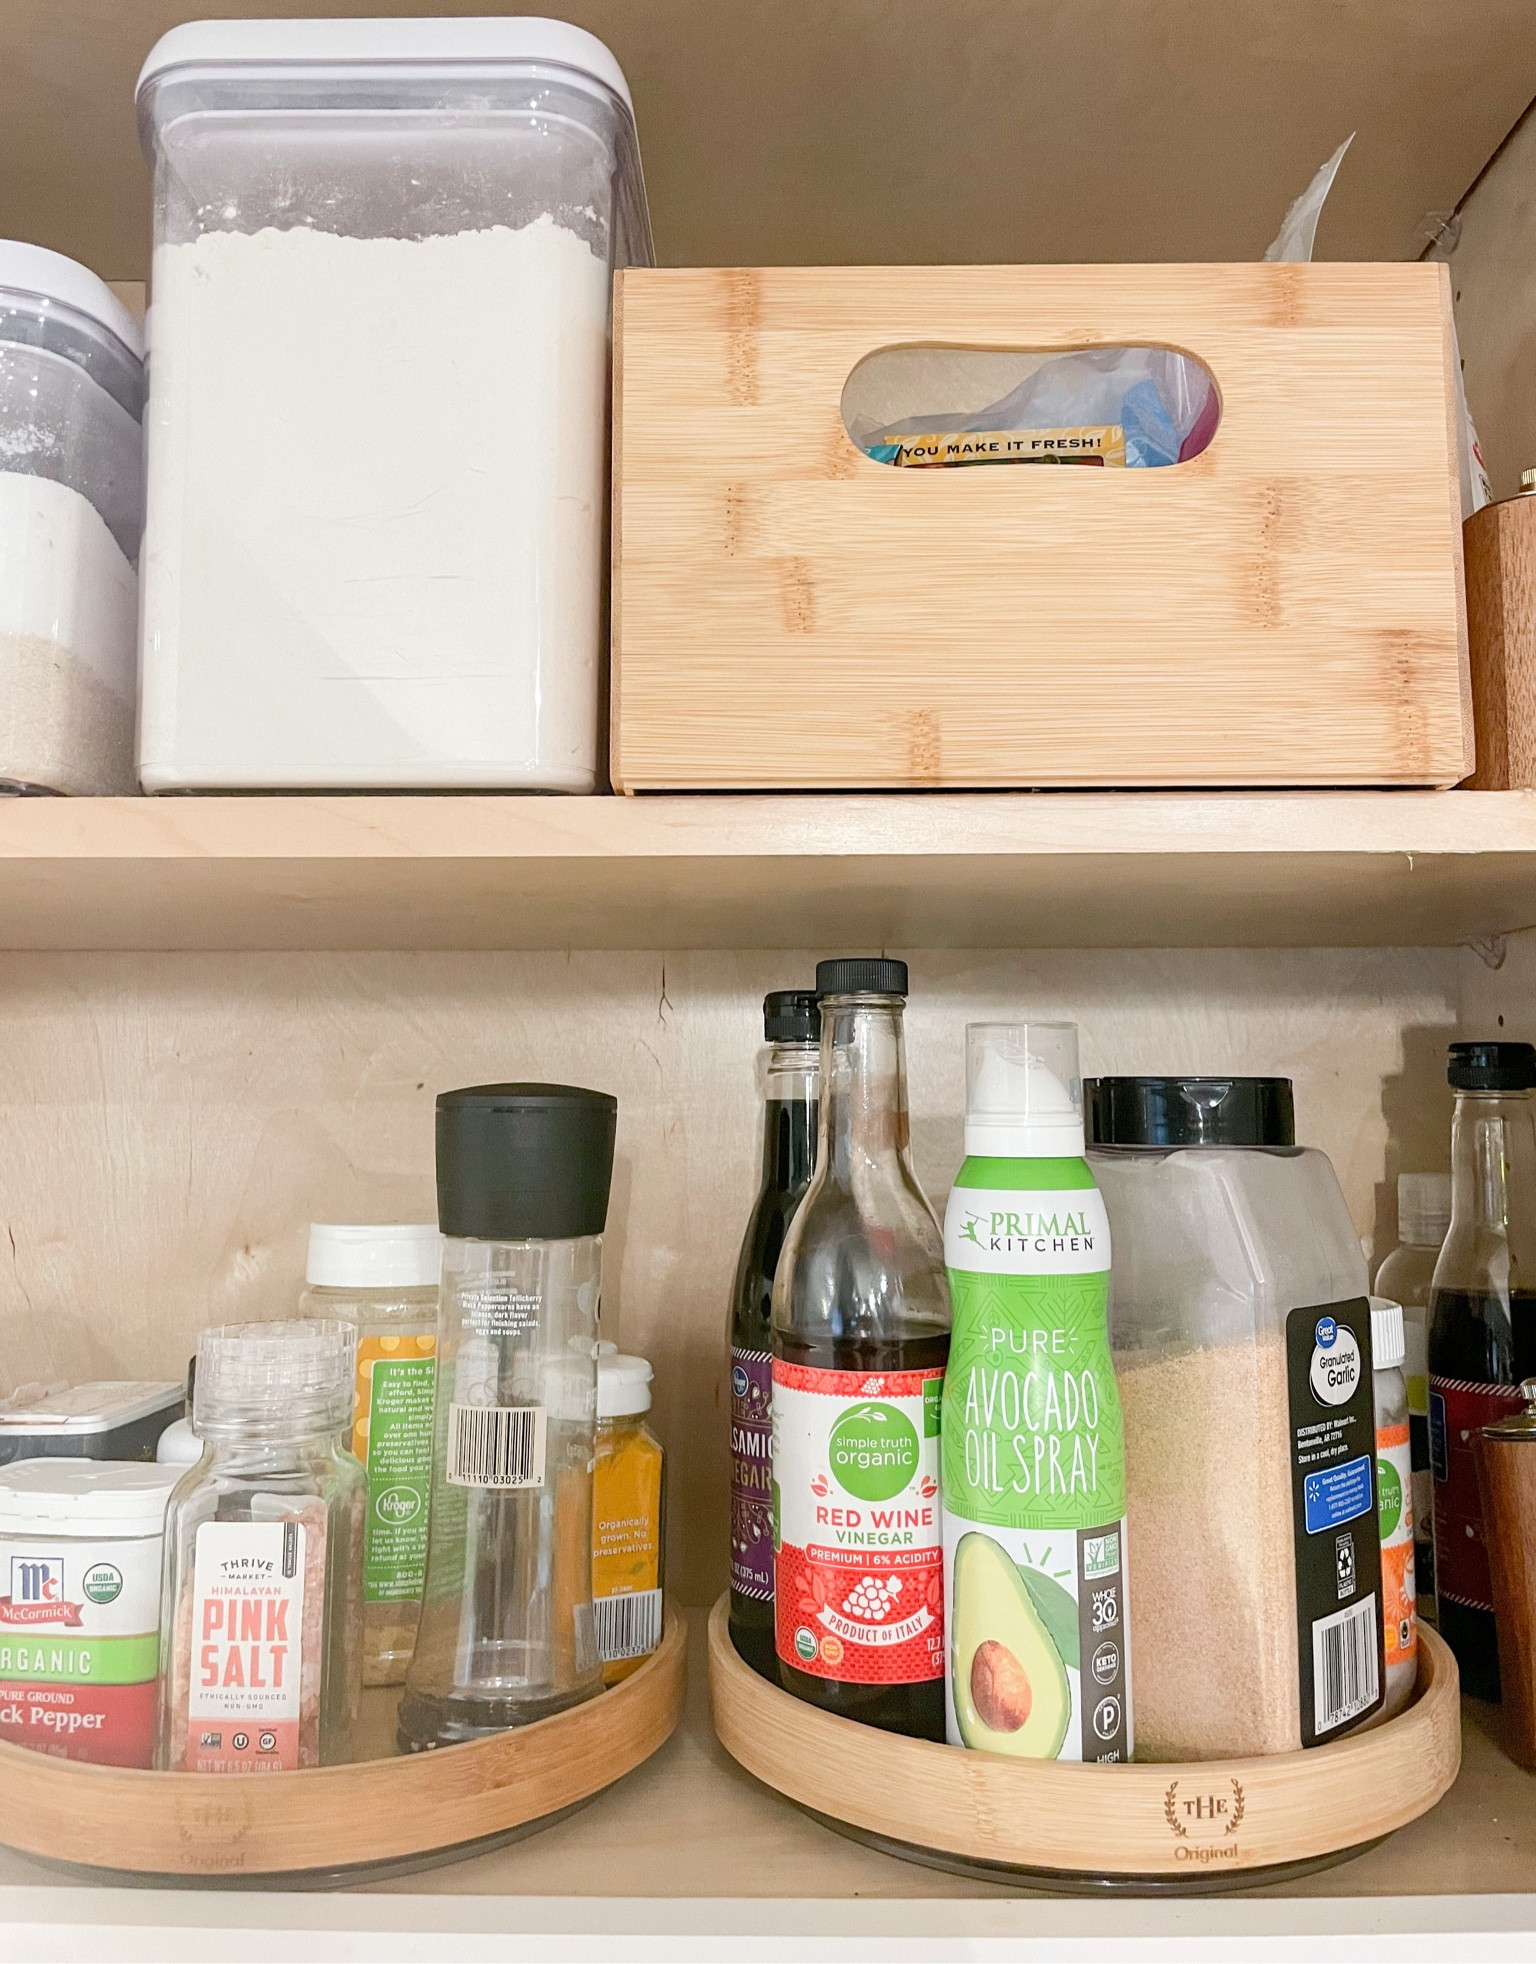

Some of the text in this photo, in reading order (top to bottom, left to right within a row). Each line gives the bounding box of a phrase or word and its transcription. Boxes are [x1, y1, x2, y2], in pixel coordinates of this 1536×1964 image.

[904, 438, 1102, 457] YOU MAKE IT FRESH!
[990, 1212, 1092, 1236] PRIMAL
[990, 1237, 1093, 1252] KITCHEN
[1318, 1324, 1334, 1336] Great
[992, 1328, 1066, 1354] PURE
[1320, 1350, 1355, 1369] Granulated
[389, 1367, 423, 1376] It's the
[1327, 1365, 1356, 1387] Garlic
[382, 1380, 400, 1388] Easy
[389, 1389, 415, 1397] afford,
[965, 1366, 1098, 1432] AVOCADO
[376, 1396, 430, 1406] Kroger makes
[377, 1440, 429, 1448] preservatives
[836, 1436, 912, 1448] simple truth
[380, 1456, 415, 1464] delicious
[384, 1448, 398, 1457] you
[836, 1448, 912, 1468] organic
[410, 1464, 424, 1472] you
[966, 1429, 1099, 1495] OIL SPRAY
[462, 1474, 488, 1484] 11110
[493, 1474, 524, 1485] 03025
[382, 1492, 416, 1518] Kroger
[598, 1516, 650, 1531] Organically
[816, 1506, 932, 1528] RED WINE
[402, 1527, 416, 1536] you
[634, 1530, 646, 1538] No
[836, 1530, 914, 1545] VINEGAR
[372, 1544, 390, 1554] right
[392, 1544, 410, 1552] with
[810, 1548, 939, 1565] PREMIUM 6% ACIDITY
[220, 1558, 274, 1572] THRIVE
[92, 1572, 114, 1582] USDA
[211, 1586, 282, 1596] HIMALAYAN
[1092, 1586, 1116, 1602] WHOLE
[2, 1605, 72, 1620] McCormick
[1092, 1598, 1117, 1626] 30
[202, 1598, 290, 1642] PINK
[828, 1614, 878, 1642] PRODUCT
[895, 1617, 924, 1640] ITALY
[926, 1636, 941, 1651] 12.7
[200, 1644, 288, 1688] SALT
[932, 1653, 945, 1668] (37
[1096, 1652, 1117, 1667] KETO
[27, 1691, 74, 1704] GROUND
[200, 1692, 244, 1700] ETHICALLY
[30, 1706, 106, 1734] Pepper
[1330, 1705, 1351, 1726] 78742
[236, 1736, 246, 1746] U
[1096, 1749, 1120, 1764] HIGH
[1183, 1794, 1228, 1819] THE
[1174, 1842, 1238, 1864] Original
